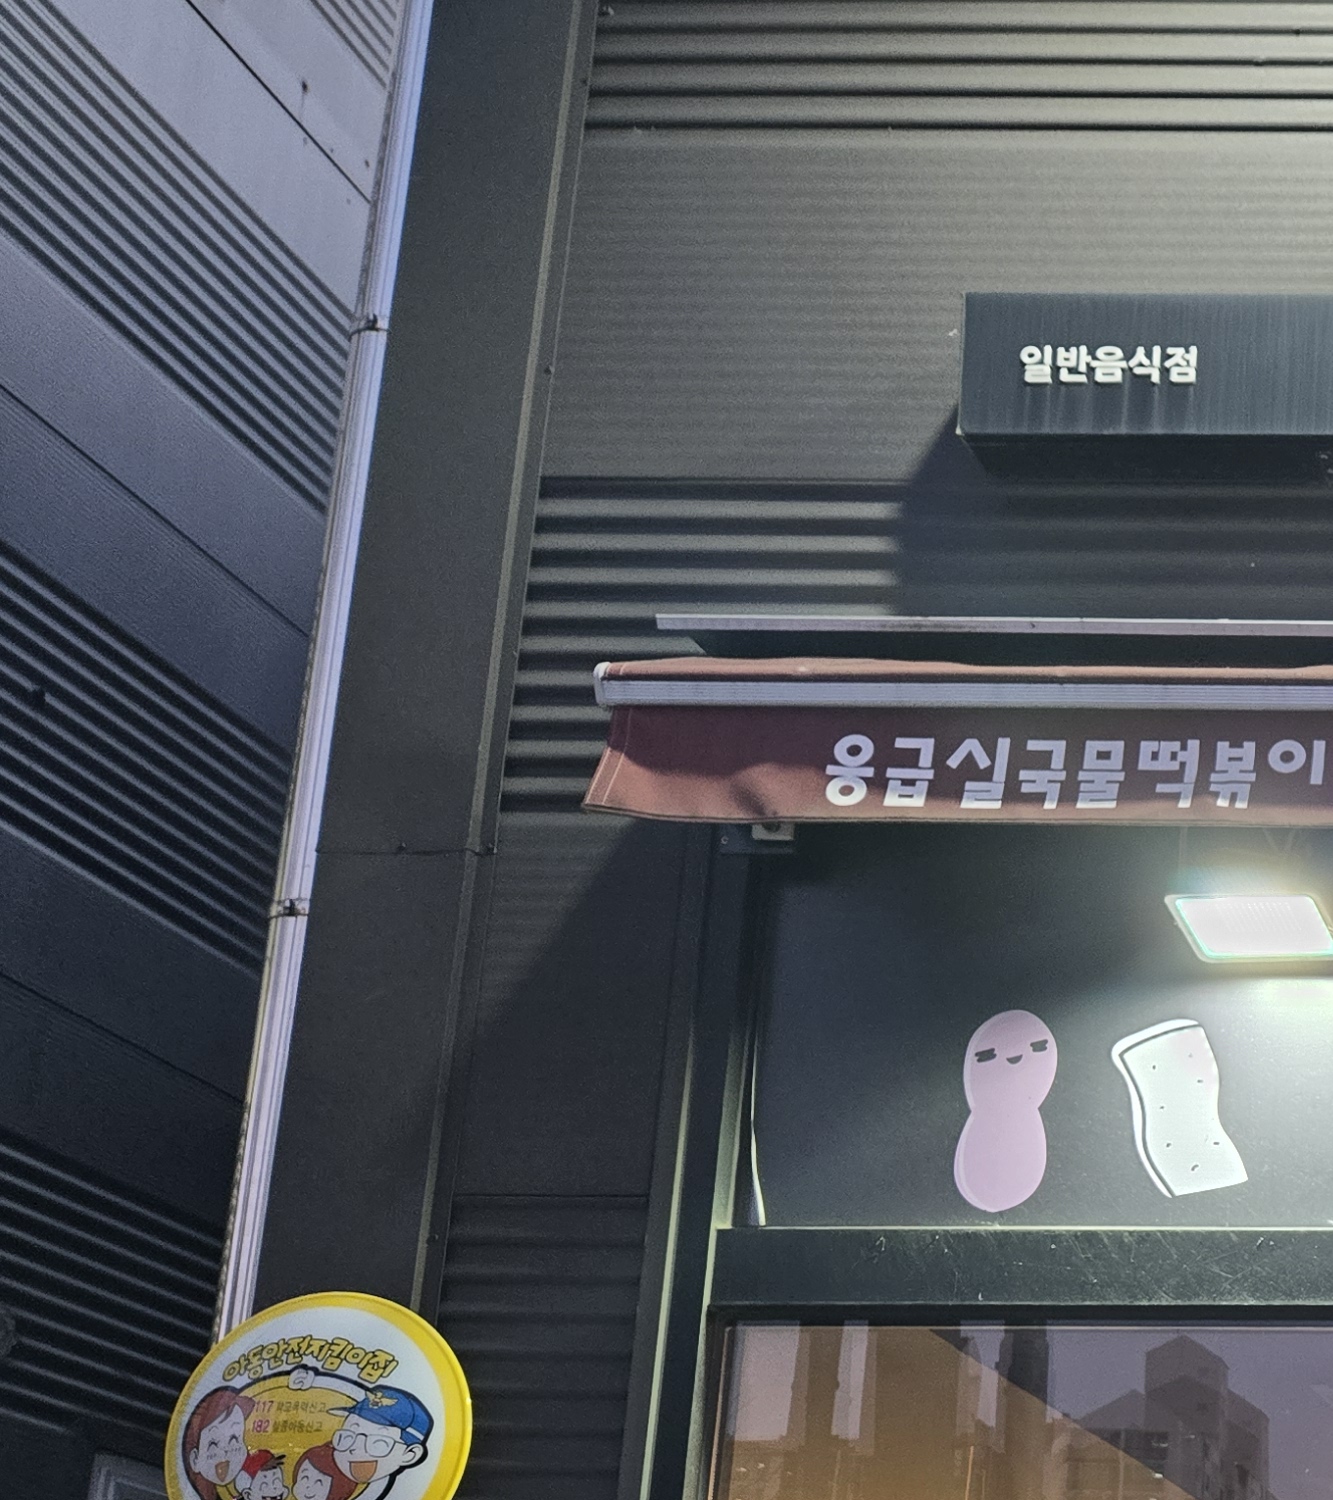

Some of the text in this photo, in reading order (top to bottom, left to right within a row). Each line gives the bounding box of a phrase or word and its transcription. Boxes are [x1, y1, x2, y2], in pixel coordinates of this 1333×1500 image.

[1018, 342, 1199, 387] 일반음식점
[824, 733, 1327, 810] 응급실국물떡볶이
[222, 1334, 399, 1384] 아동안전지킴이집
[252, 1420, 270, 1433] 182
